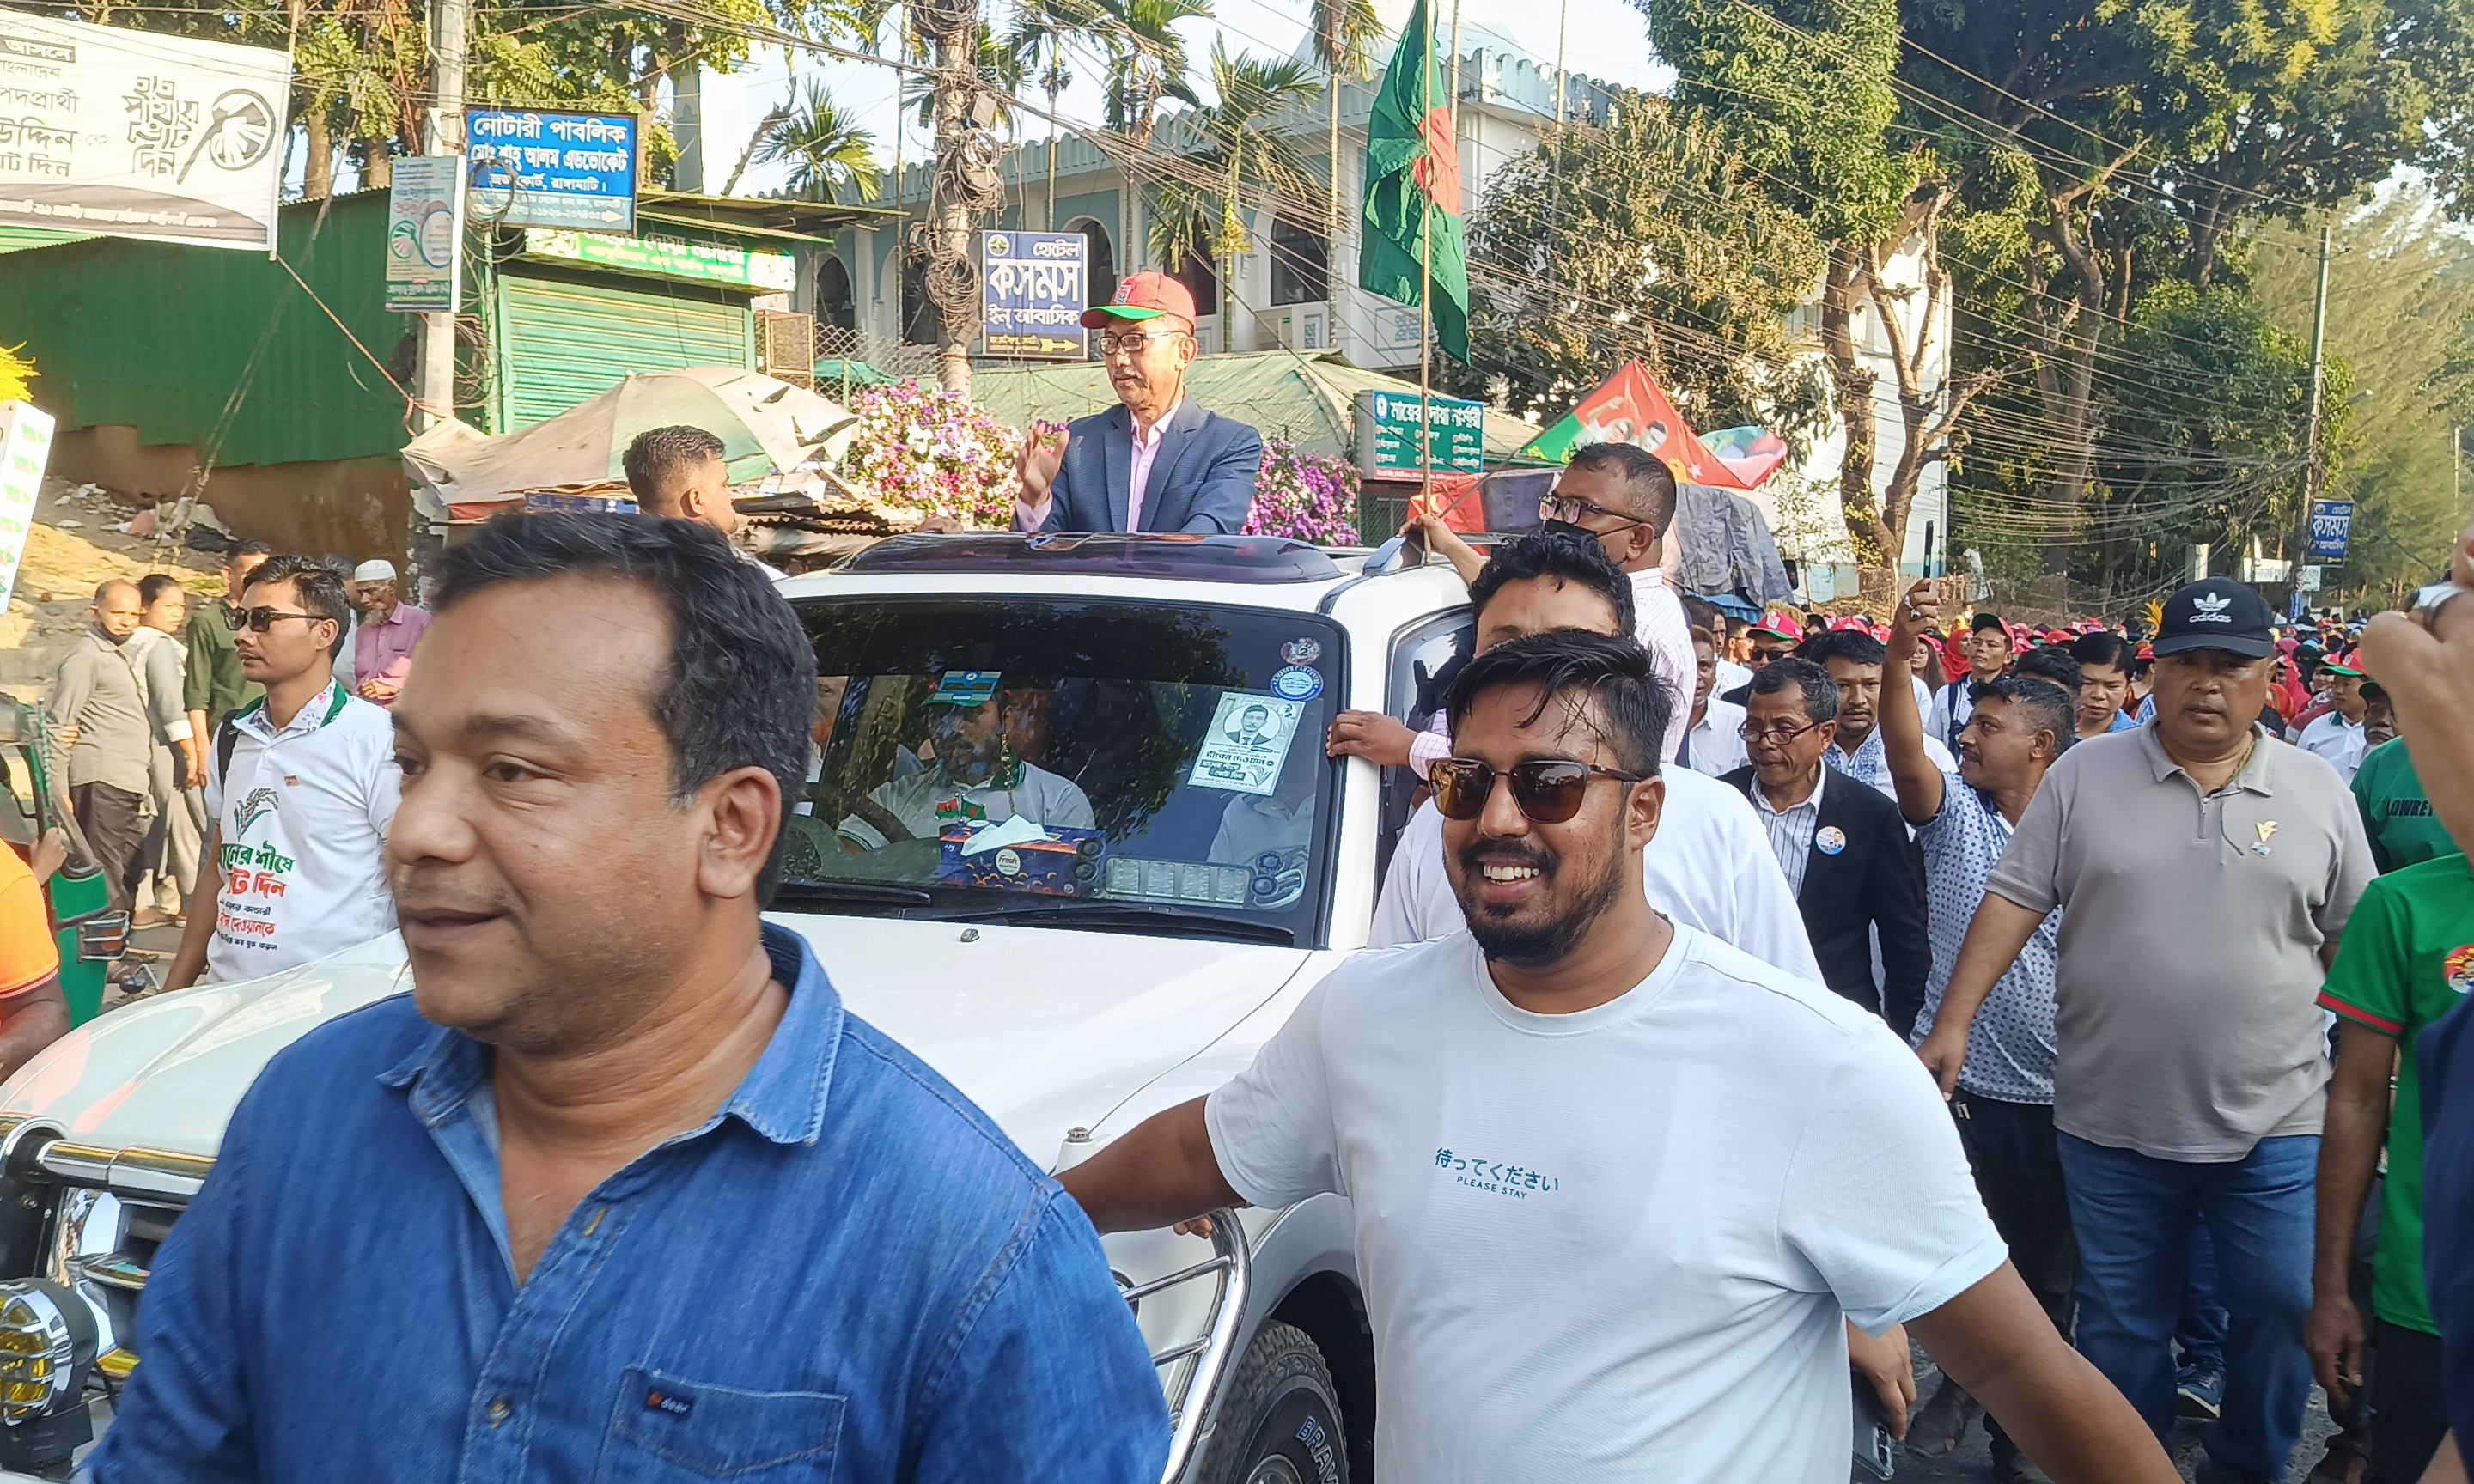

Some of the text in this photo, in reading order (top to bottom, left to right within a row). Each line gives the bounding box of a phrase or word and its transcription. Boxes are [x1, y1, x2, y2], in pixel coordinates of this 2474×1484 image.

[0, 60, 62, 79] াংলাদেশ
[133, 76, 176, 101] হাত
[122, 94, 199, 126] পাখায়
[127, 120, 192, 149] ভোট
[474, 112, 628, 144] নোটারী পাবলিক
[28, 153, 71, 177] দিন
[131, 144, 175, 178] দিন
[523, 145, 560, 169] আলম
[563, 147, 628, 172] এডভোকেট
[1033, 239, 1081, 258] হোটেল
[988, 258, 1081, 301] কসমস
[1014, 302, 1080, 325] আবাসিক
[2313, 515, 2351, 538] কসমস
[2189, 612, 2232, 623] adidas
[255, 840, 296, 873] শীষে
[253, 872, 288, 898] দিন
[1435, 1146, 1559, 1192] 待ってください
[1457, 1176, 1527, 1200] PLEASE STAY
